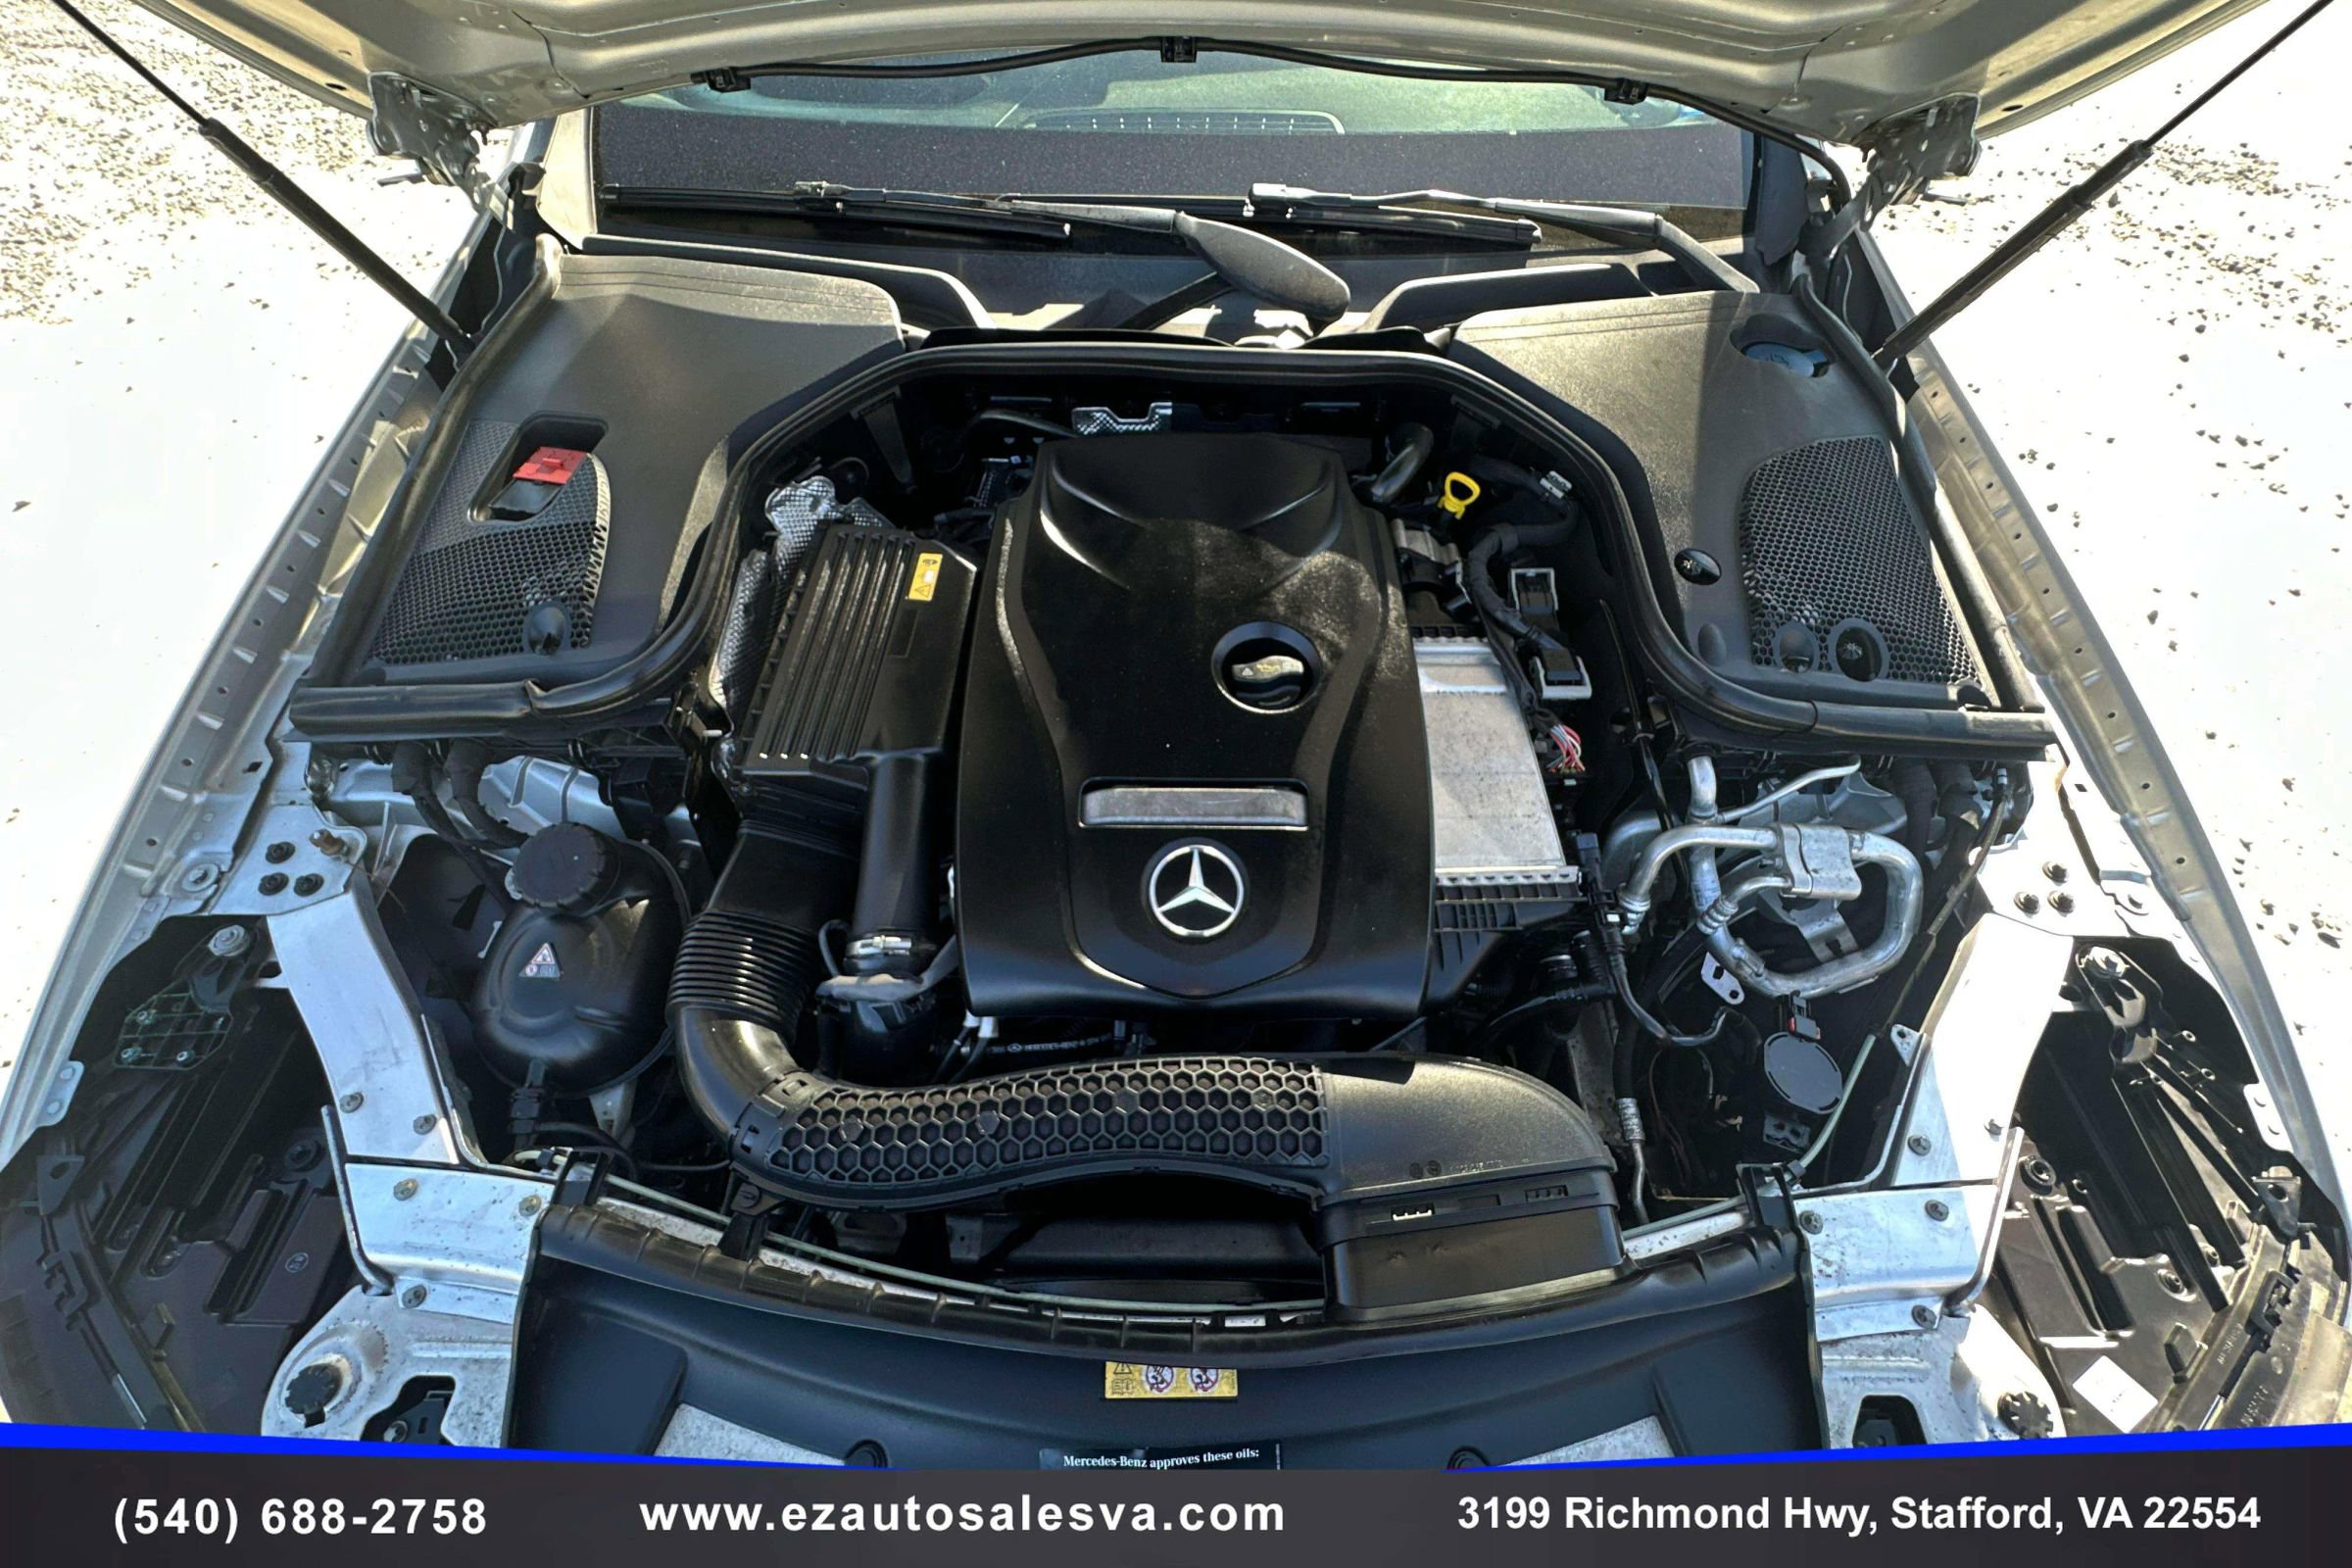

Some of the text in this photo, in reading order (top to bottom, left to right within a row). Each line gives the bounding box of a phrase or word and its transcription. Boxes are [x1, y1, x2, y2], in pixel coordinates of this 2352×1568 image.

[1063, 1447, 1259, 1470] Mercedes-Benz approves these oils:
